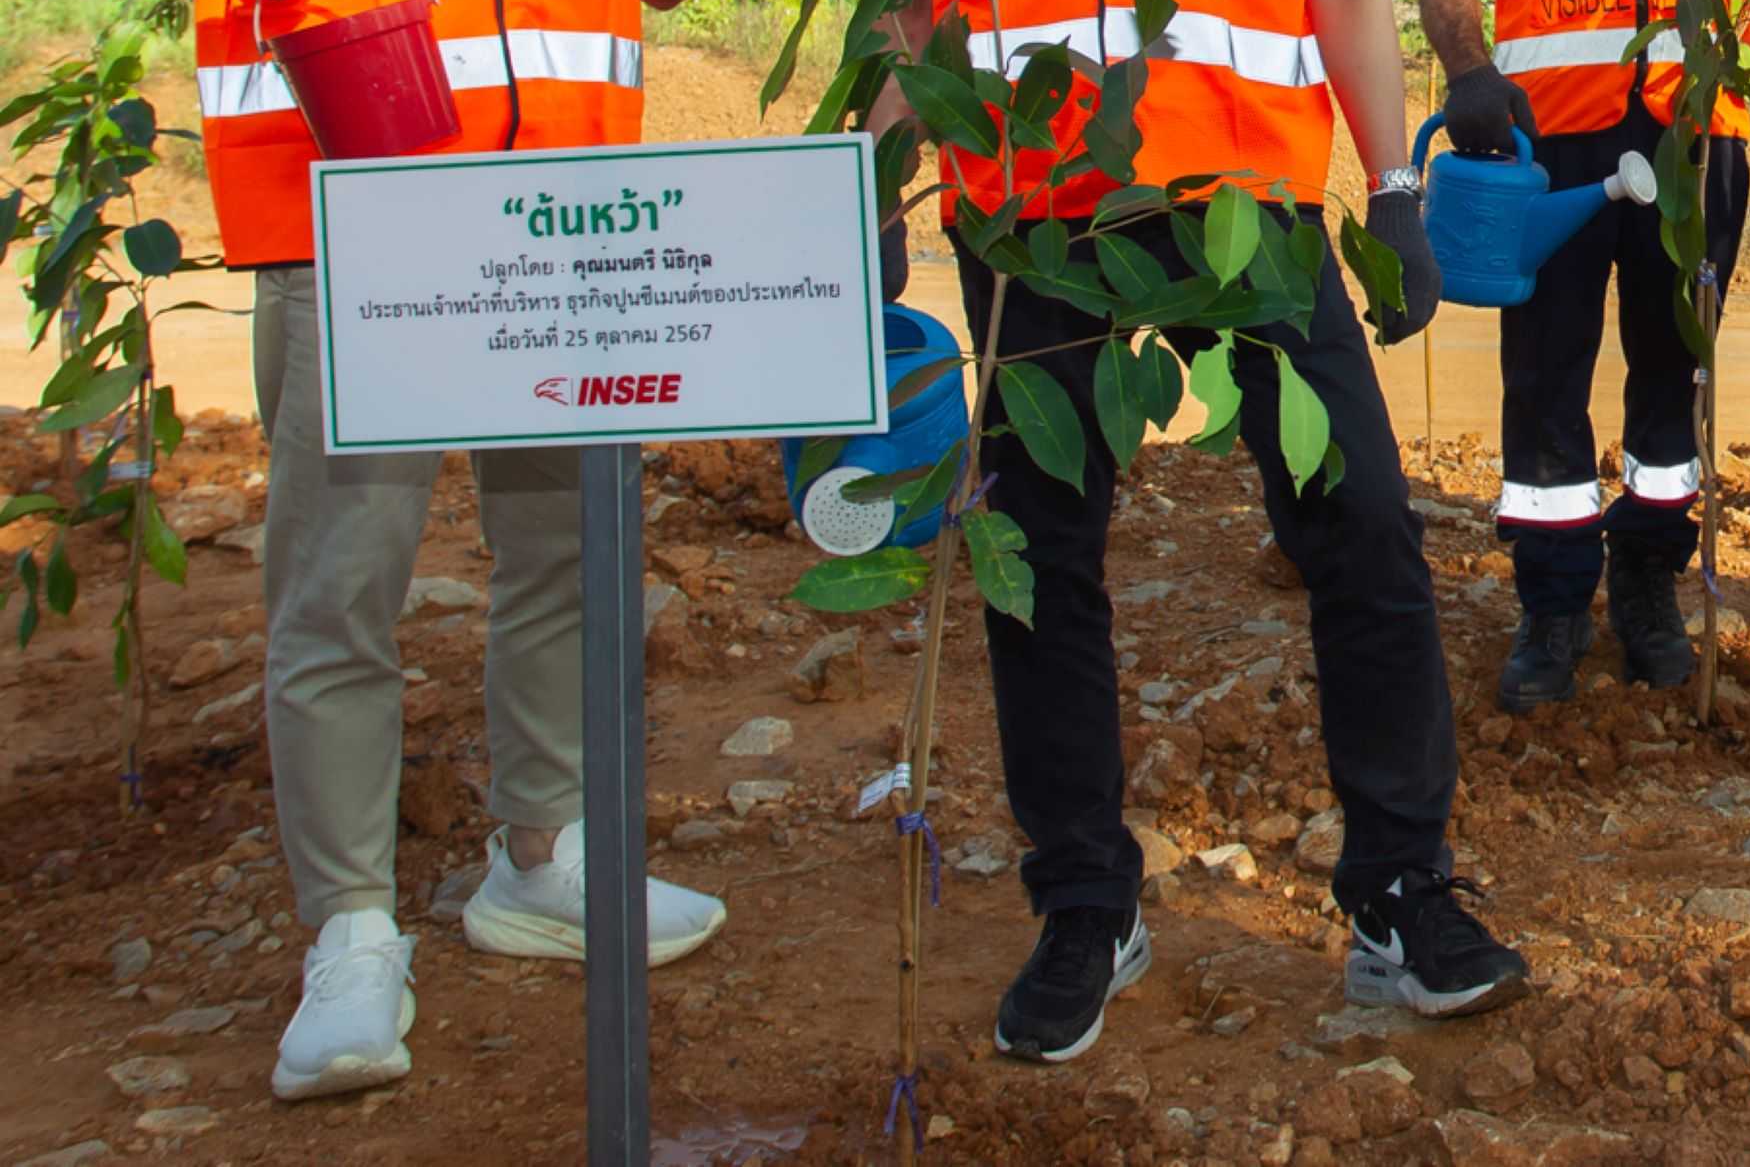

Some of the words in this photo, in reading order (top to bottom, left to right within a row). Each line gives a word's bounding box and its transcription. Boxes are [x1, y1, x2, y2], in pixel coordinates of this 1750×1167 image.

[503, 188, 683, 238] “ต้นหว้า”
[480, 254, 554, 284] ปลูกโดย
[573, 248, 656, 281] คุณมนตรี
[662, 247, 712, 276] นิธิกุล
[359, 286, 560, 320] ประธานเจ้าหน้าที่บริหาร
[566, 276, 841, 316] ธุรกิจปูนซีเมนต์ของประเทศไทย
[488, 320, 559, 352] เมื่อวันที่
[564, 330, 589, 347] 25
[595, 327, 658, 352] ตุลาคม
[664, 324, 713, 344] 2567
[577, 373, 682, 407] INSEE
